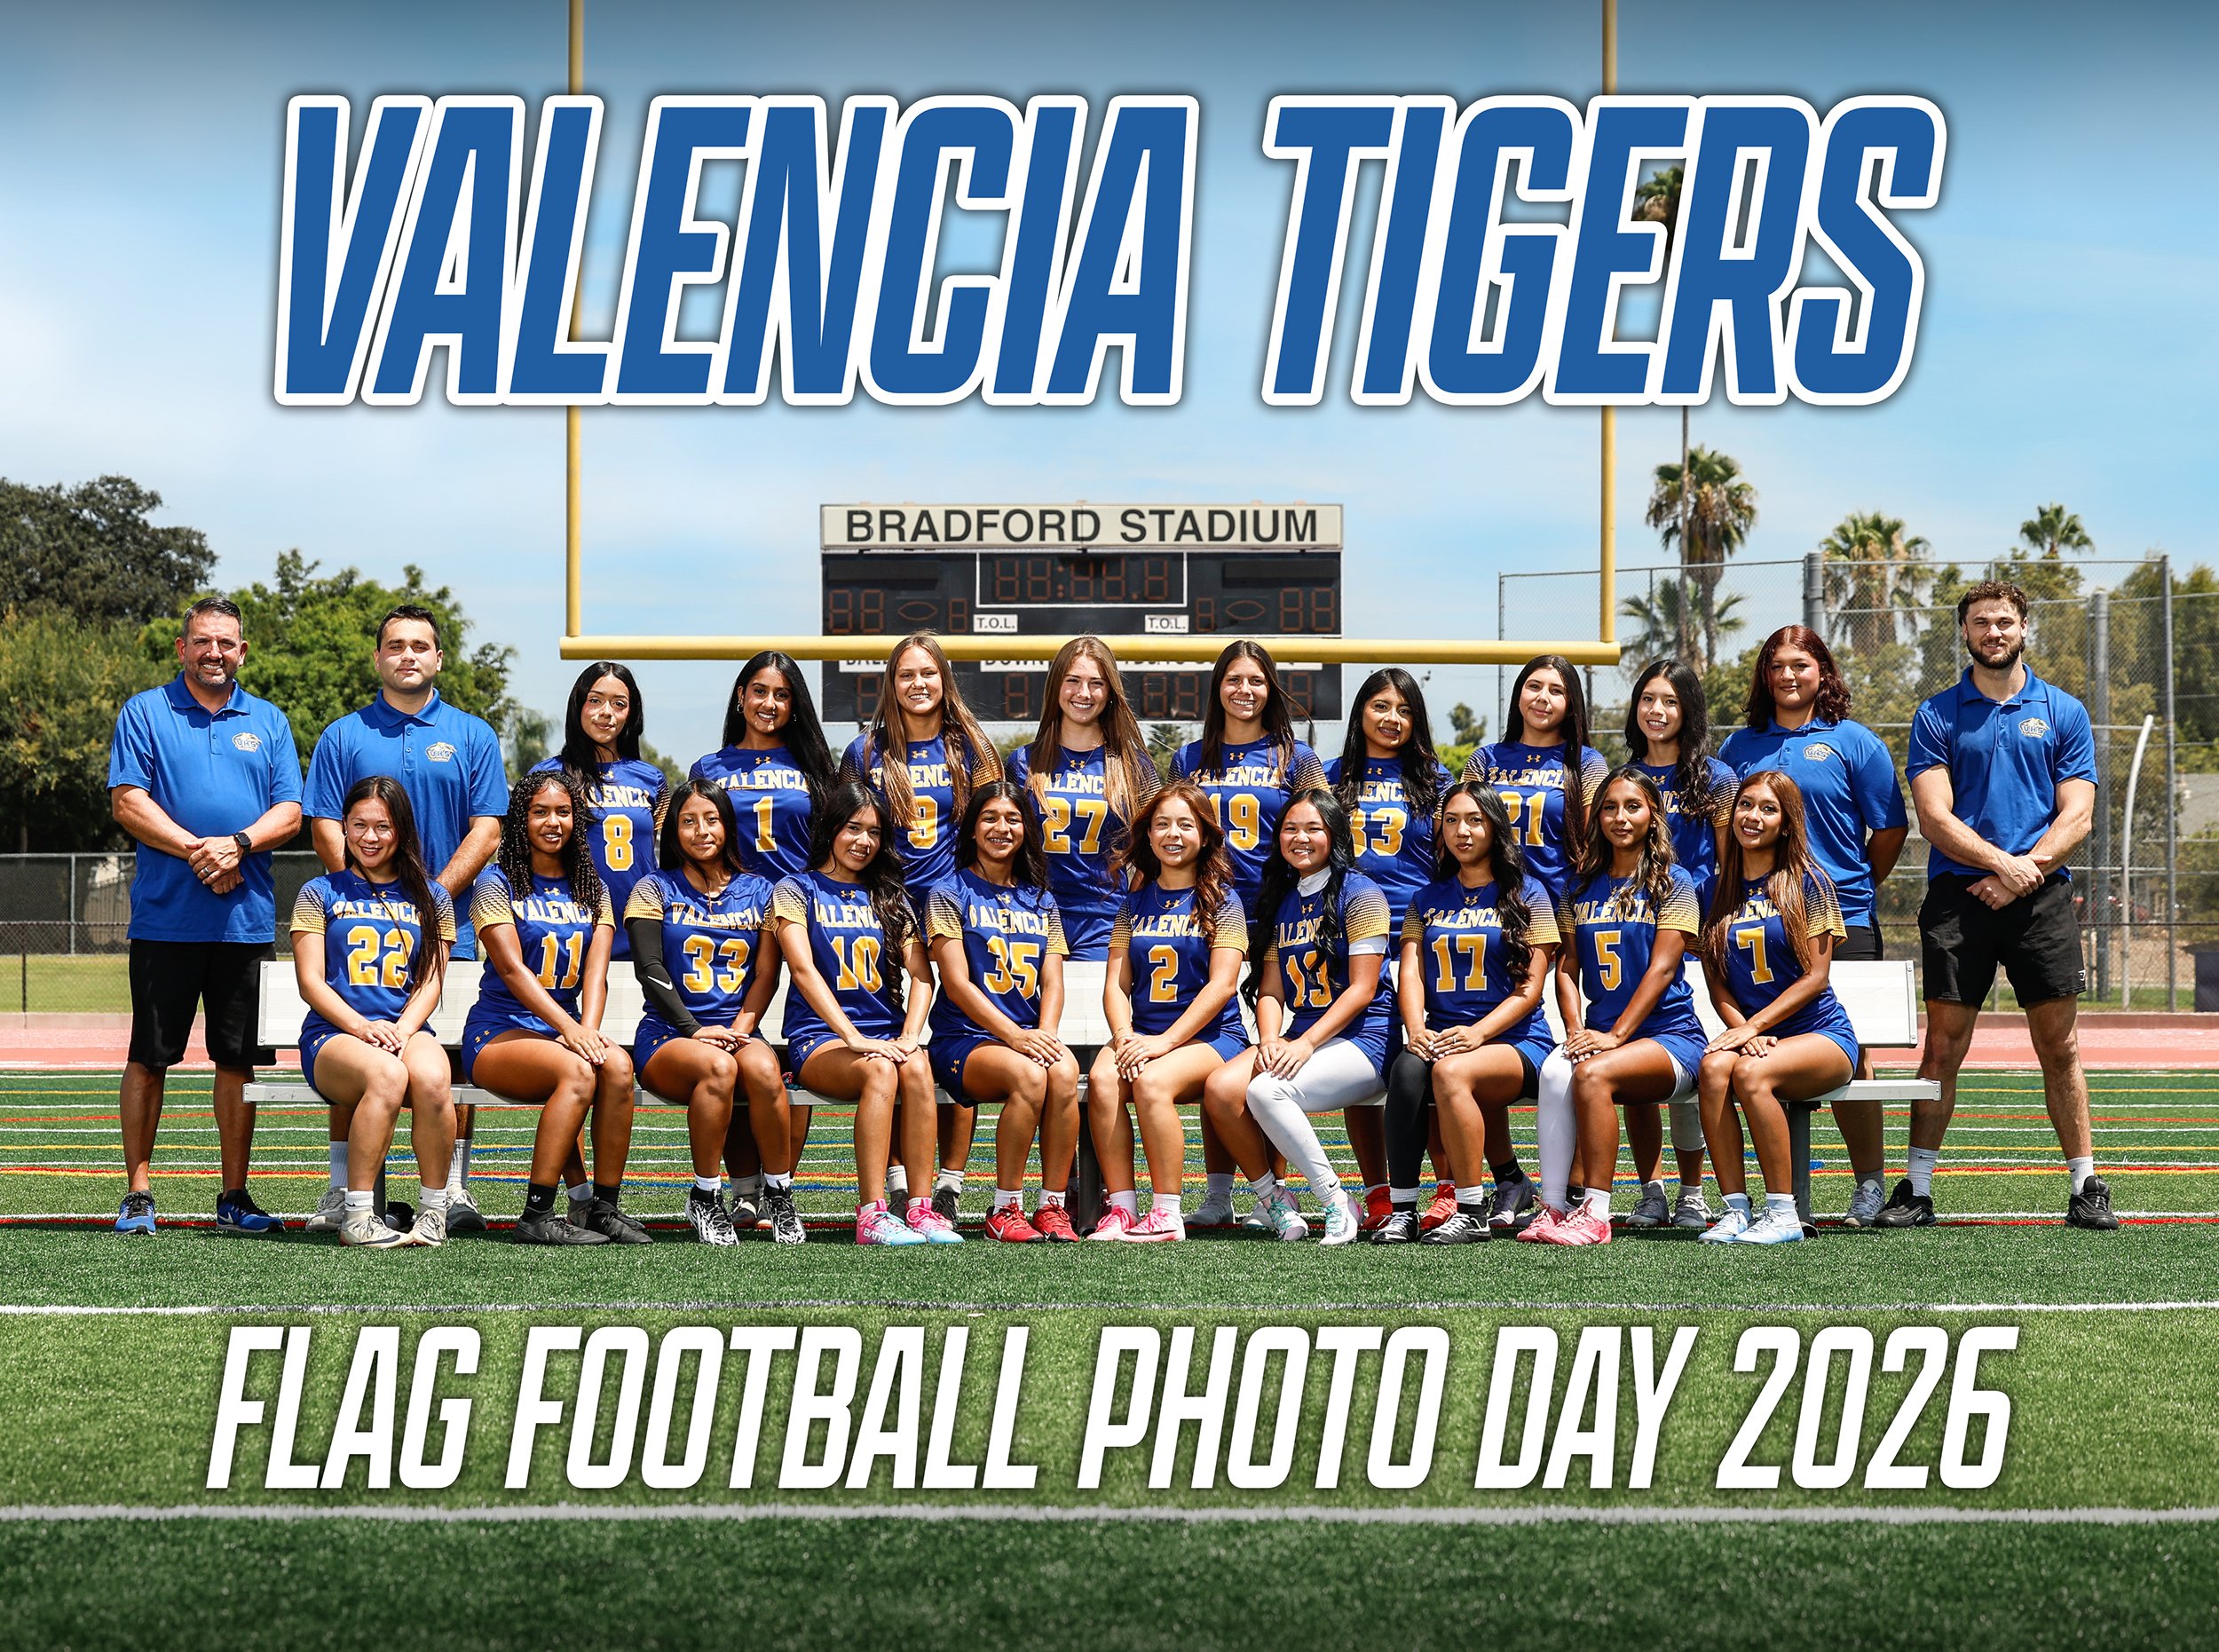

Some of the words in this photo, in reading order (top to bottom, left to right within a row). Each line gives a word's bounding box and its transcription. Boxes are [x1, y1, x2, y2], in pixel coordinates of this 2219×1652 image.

[846, 509, 1101, 542] BRADFORD
[1119, 509, 1317, 542] STADIUM
[976, 617, 1016, 630] T.O.L.
[1148, 617, 1187, 630] T.O.L.
[1488, 766, 1565, 789] VALENCI
[603, 814, 634, 872] 8
[753, 795, 778, 852] 1
[907, 795, 938, 850] 9
[1039, 796, 1108, 854] 27
[1209, 793, 1260, 850] 19
[332, 900, 421, 927] VALENCI
[511, 899, 593, 925] VALENCI
[671, 901, 762, 930] VALENCIA
[1423, 907, 1503, 929] VALENCI
[347, 925, 415, 989] 22
[536, 930, 584, 990] 11
[683, 934, 750, 994] 33
[830, 936, 883, 993] 10
[983, 935, 1040, 1000] 35
[1148, 945, 1179, 1003] 2
[1431, 934, 1488, 992] 17
[1594, 929, 1622, 991] 5
[1736, 925, 1775, 985] 7
